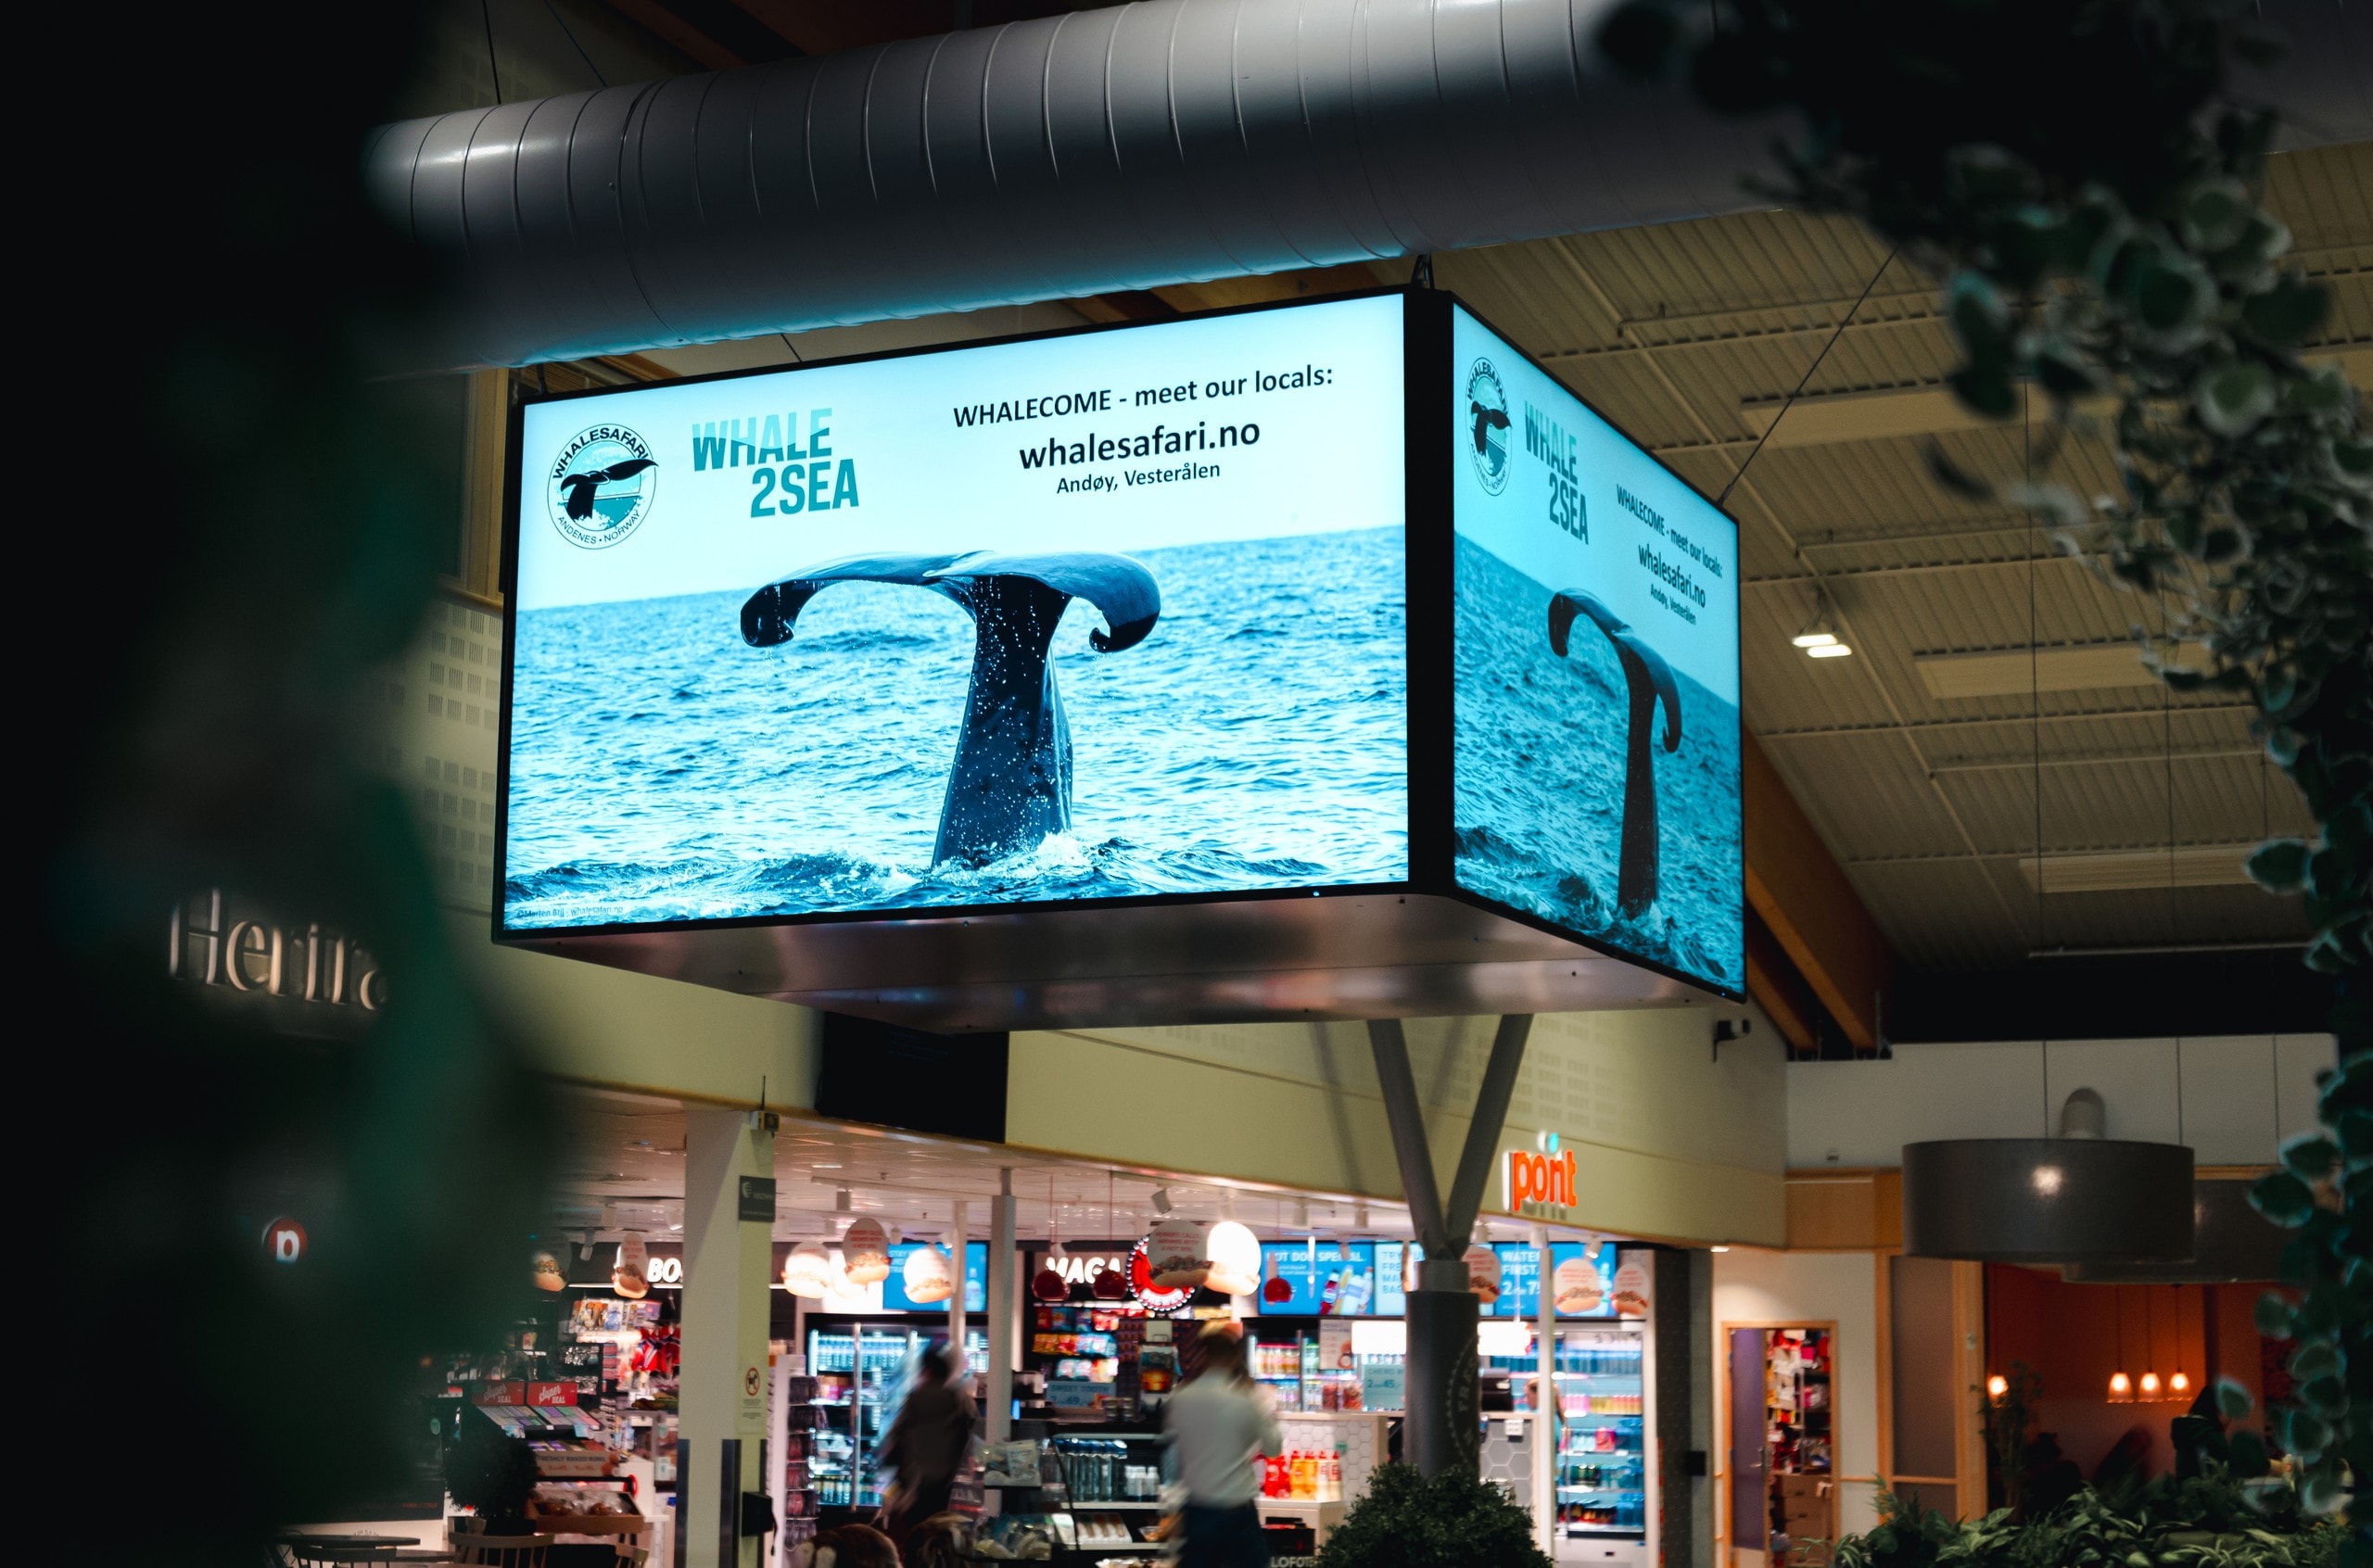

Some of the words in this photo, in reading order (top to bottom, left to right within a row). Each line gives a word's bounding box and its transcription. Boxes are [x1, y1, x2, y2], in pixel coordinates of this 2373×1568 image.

[953, 389, 1111, 427] WHALECOME
[1135, 381, 1198, 407] meet
[1205, 377, 1248, 398] our
[1255, 364, 1333, 393] locals:
[552, 427, 649, 479] WHALESAFARI
[692, 407, 833, 472] WHALE
[1019, 422, 1261, 470] whalesafari.no
[1525, 400, 1579, 487] WHALE
[750, 458, 859, 518] 2SEA
[1056, 474, 1118, 494] Andøy,
[1124, 462, 1221, 487] Vesterålen
[558, 516, 597, 544] ANDENES
[604, 509, 641, 543] NORWAY
[1549, 472, 1589, 546] 2SEA
[1617, 483, 1666, 537] WHALECOME
[1670, 528, 1689, 554] meet
[1690, 543, 1702, 563] our
[1638, 543, 1707, 609] whalesafari.no
[647, 1257, 683, 1283] BO
